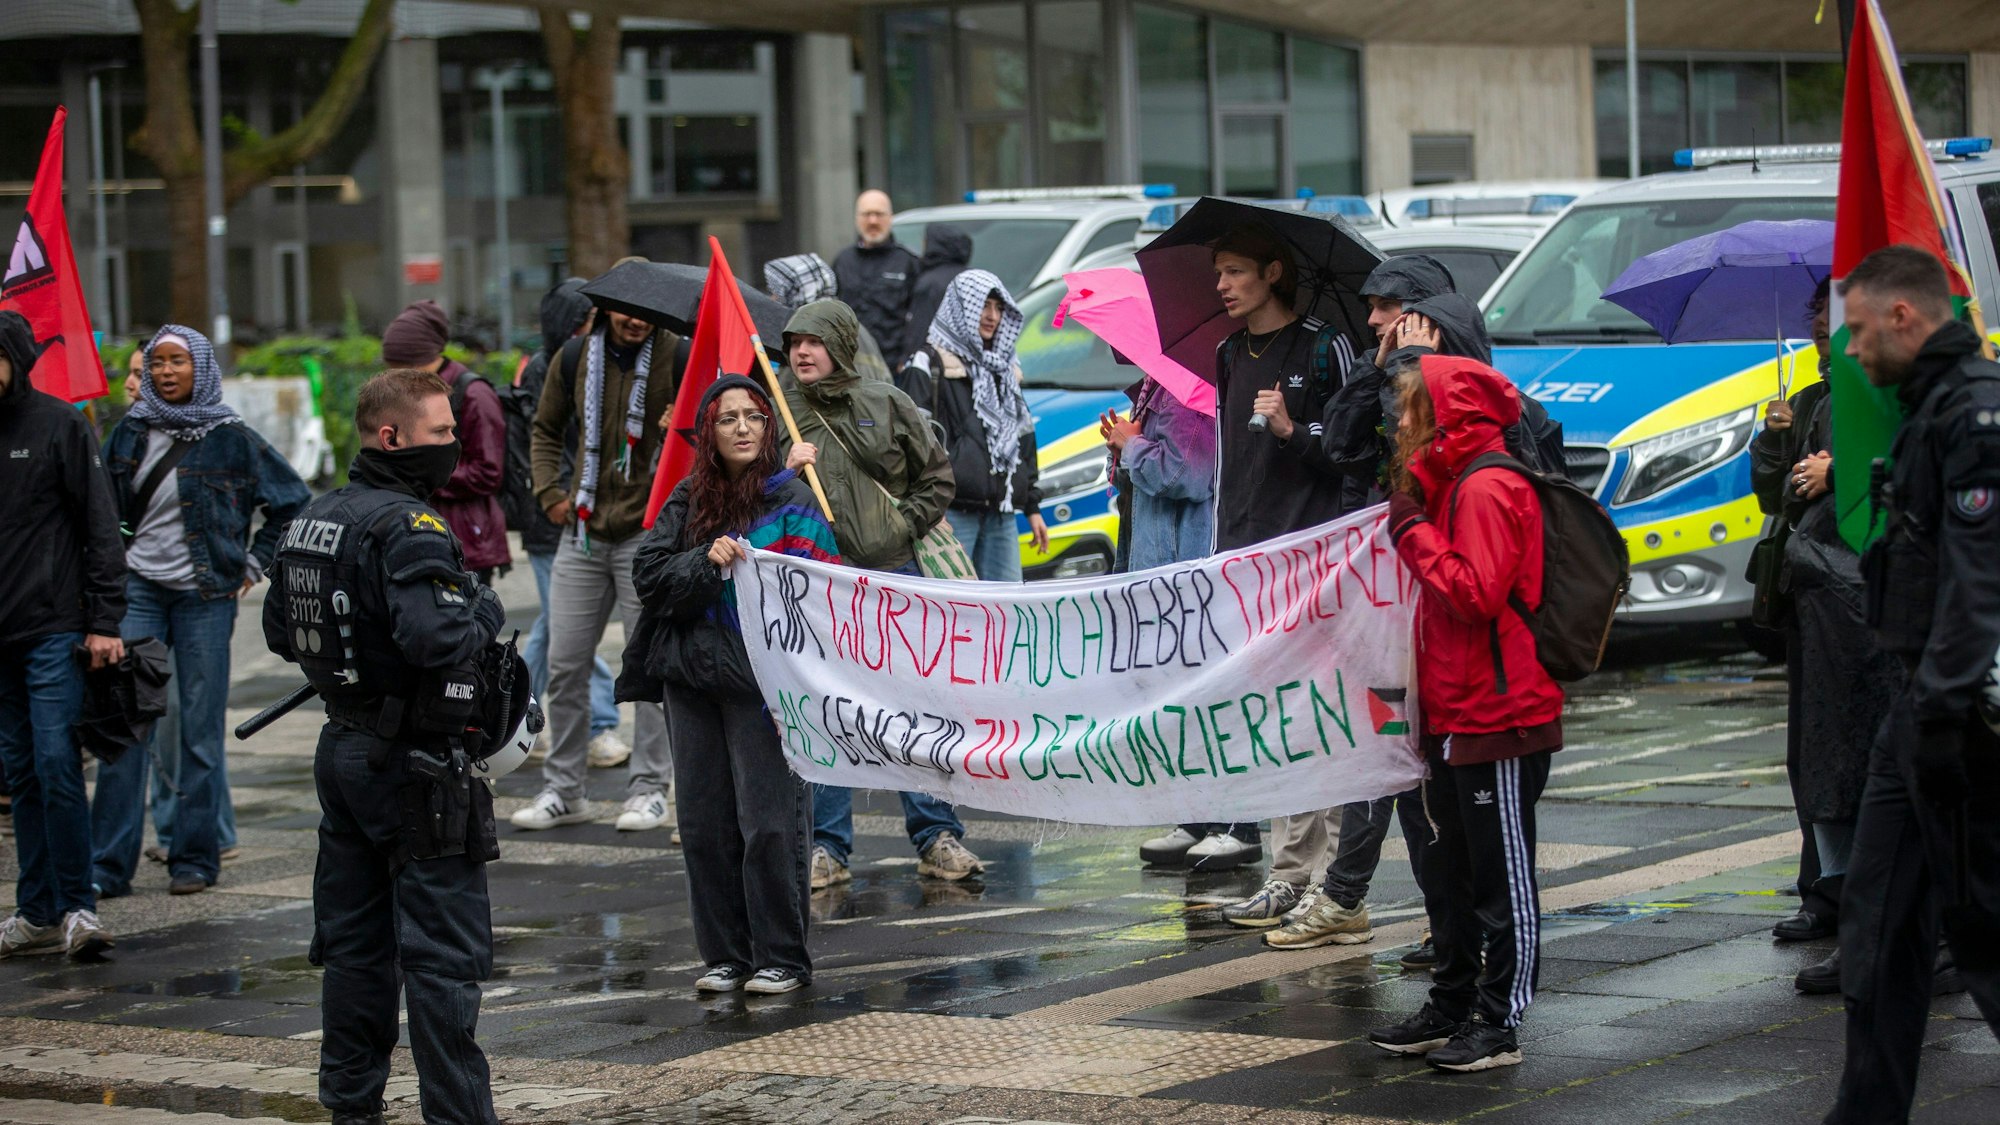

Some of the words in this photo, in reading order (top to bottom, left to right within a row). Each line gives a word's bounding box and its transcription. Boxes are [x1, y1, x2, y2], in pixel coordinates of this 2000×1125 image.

[1524, 382, 1614, 403] IZEI
[288, 566, 321, 594] NRW
[289, 595, 323, 624] 31112
[754, 557, 826, 660] WIR
[827, 575, 1006, 685] WÜRDEN
[1004, 591, 1103, 687] AUCH
[1103, 568, 1229, 673] LIEBER
[444, 682, 475, 700] MEDIC
[779, 689, 836, 768] ALS
[963, 718, 1019, 779] ZU
[1019, 668, 1356, 787] DENUNZIEREN
